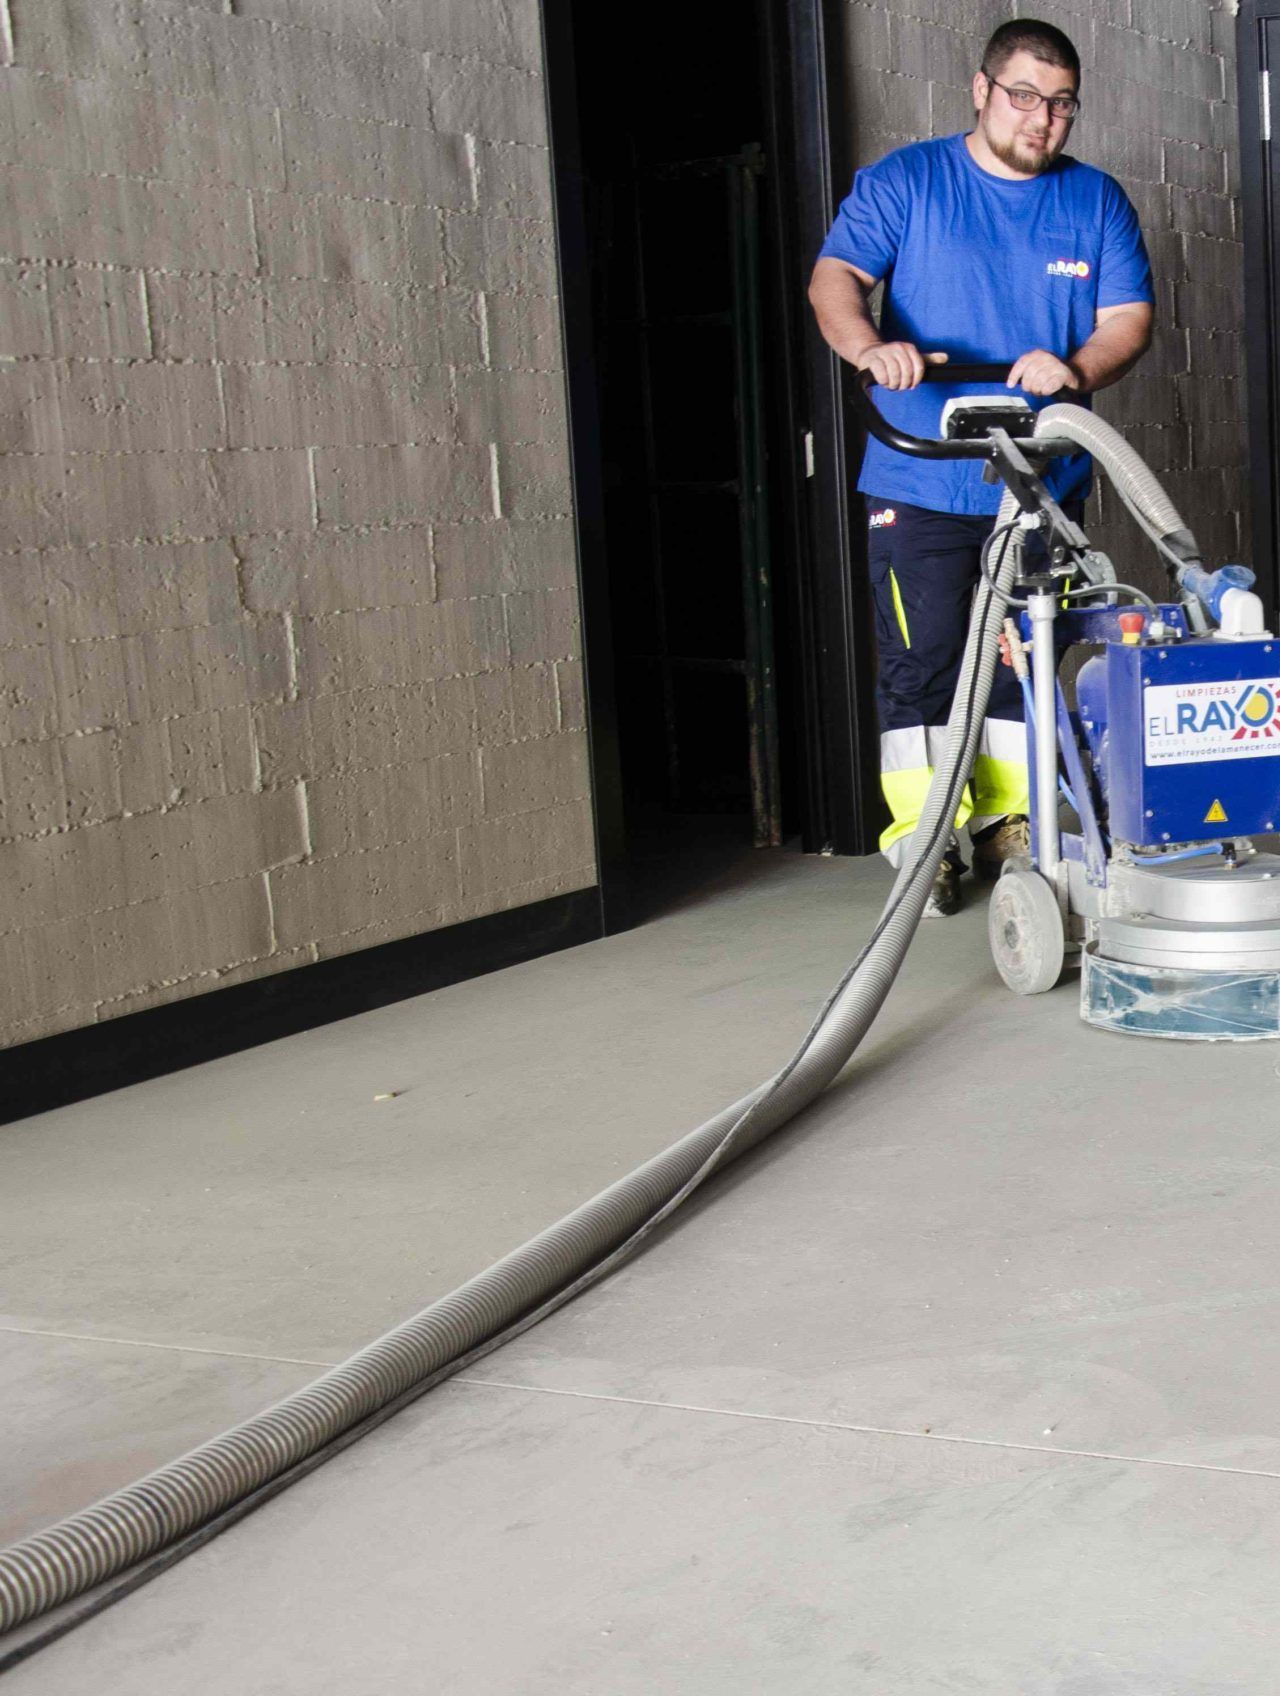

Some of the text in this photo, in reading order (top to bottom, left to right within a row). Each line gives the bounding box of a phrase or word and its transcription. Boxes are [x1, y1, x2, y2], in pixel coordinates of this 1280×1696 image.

[1176, 686, 1237, 698] LIMPIEZAS
[1150, 685, 1275, 737] EL RAYO
